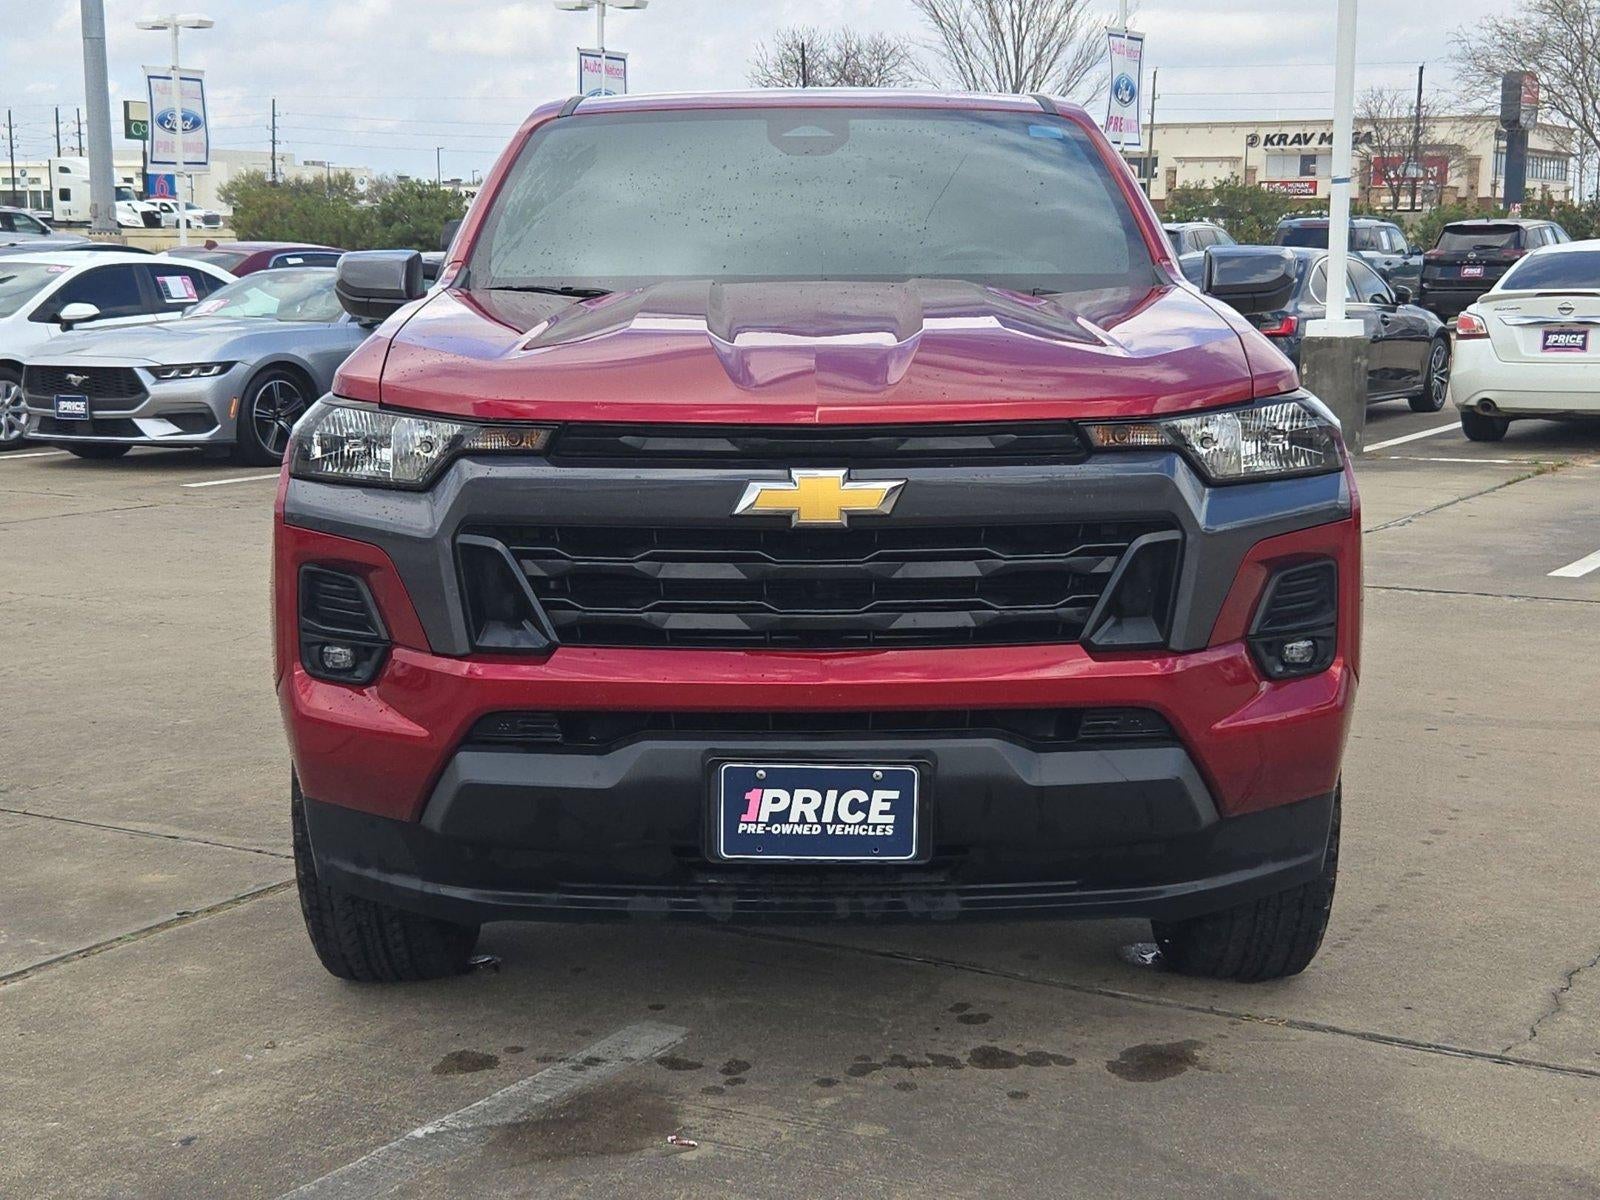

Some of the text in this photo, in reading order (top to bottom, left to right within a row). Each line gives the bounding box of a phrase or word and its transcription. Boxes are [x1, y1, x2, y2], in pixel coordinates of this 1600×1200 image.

[1263, 132, 1316, 147] KRAV
[1547, 334, 1585, 344] 1PRICE
[740, 788, 900, 824] 1PRICE
[738, 823, 894, 836] PRE-OWNED VEHICLES
